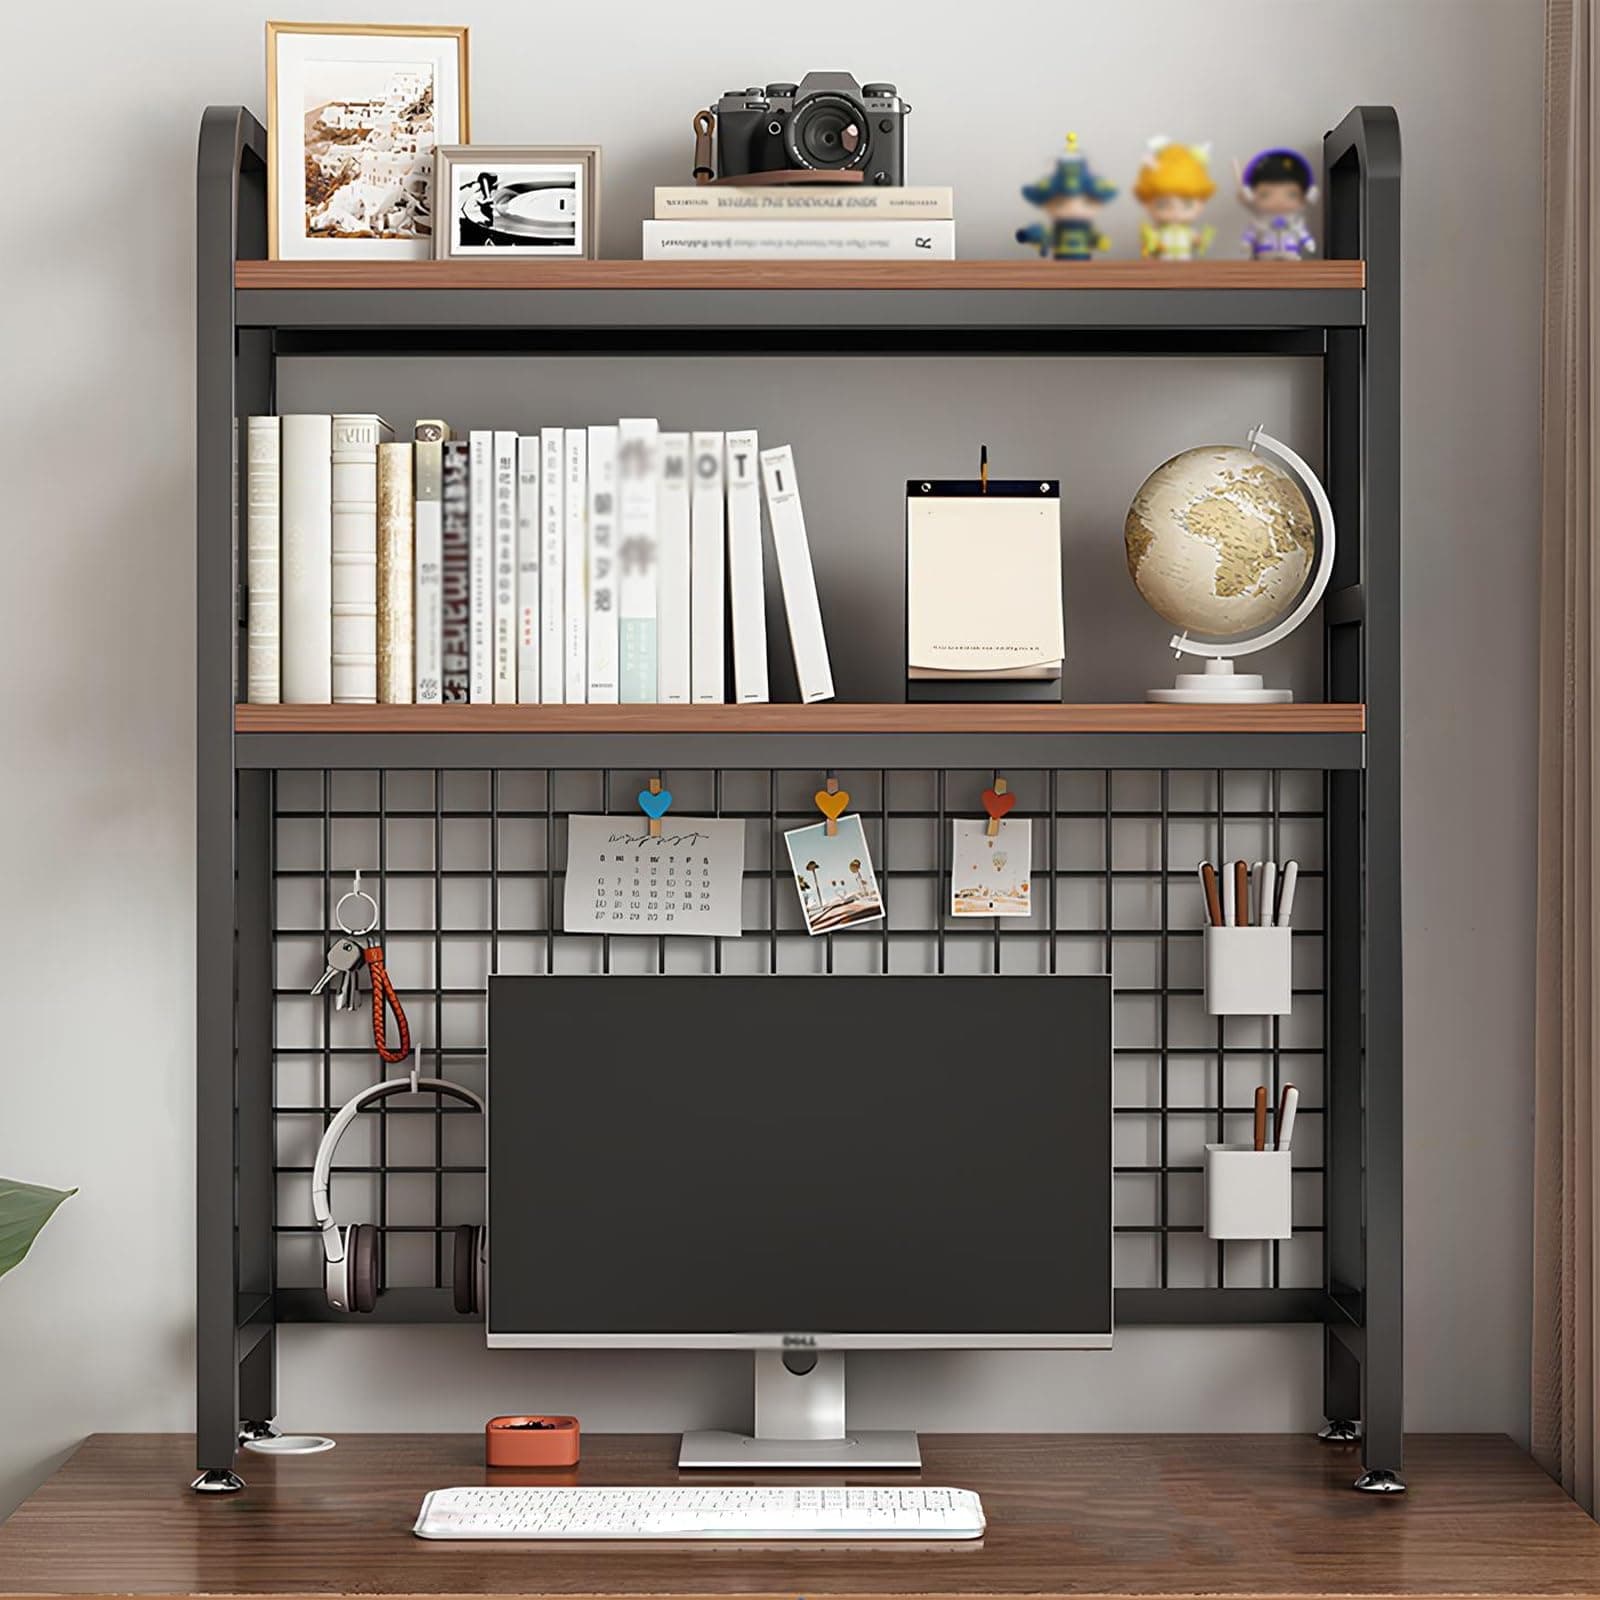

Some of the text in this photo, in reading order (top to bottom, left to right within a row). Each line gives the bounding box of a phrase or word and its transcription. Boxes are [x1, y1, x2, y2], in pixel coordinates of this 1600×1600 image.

[915, 237, 932, 249] R
[698, 453, 718, 479] O
[735, 453, 748, 478] T
